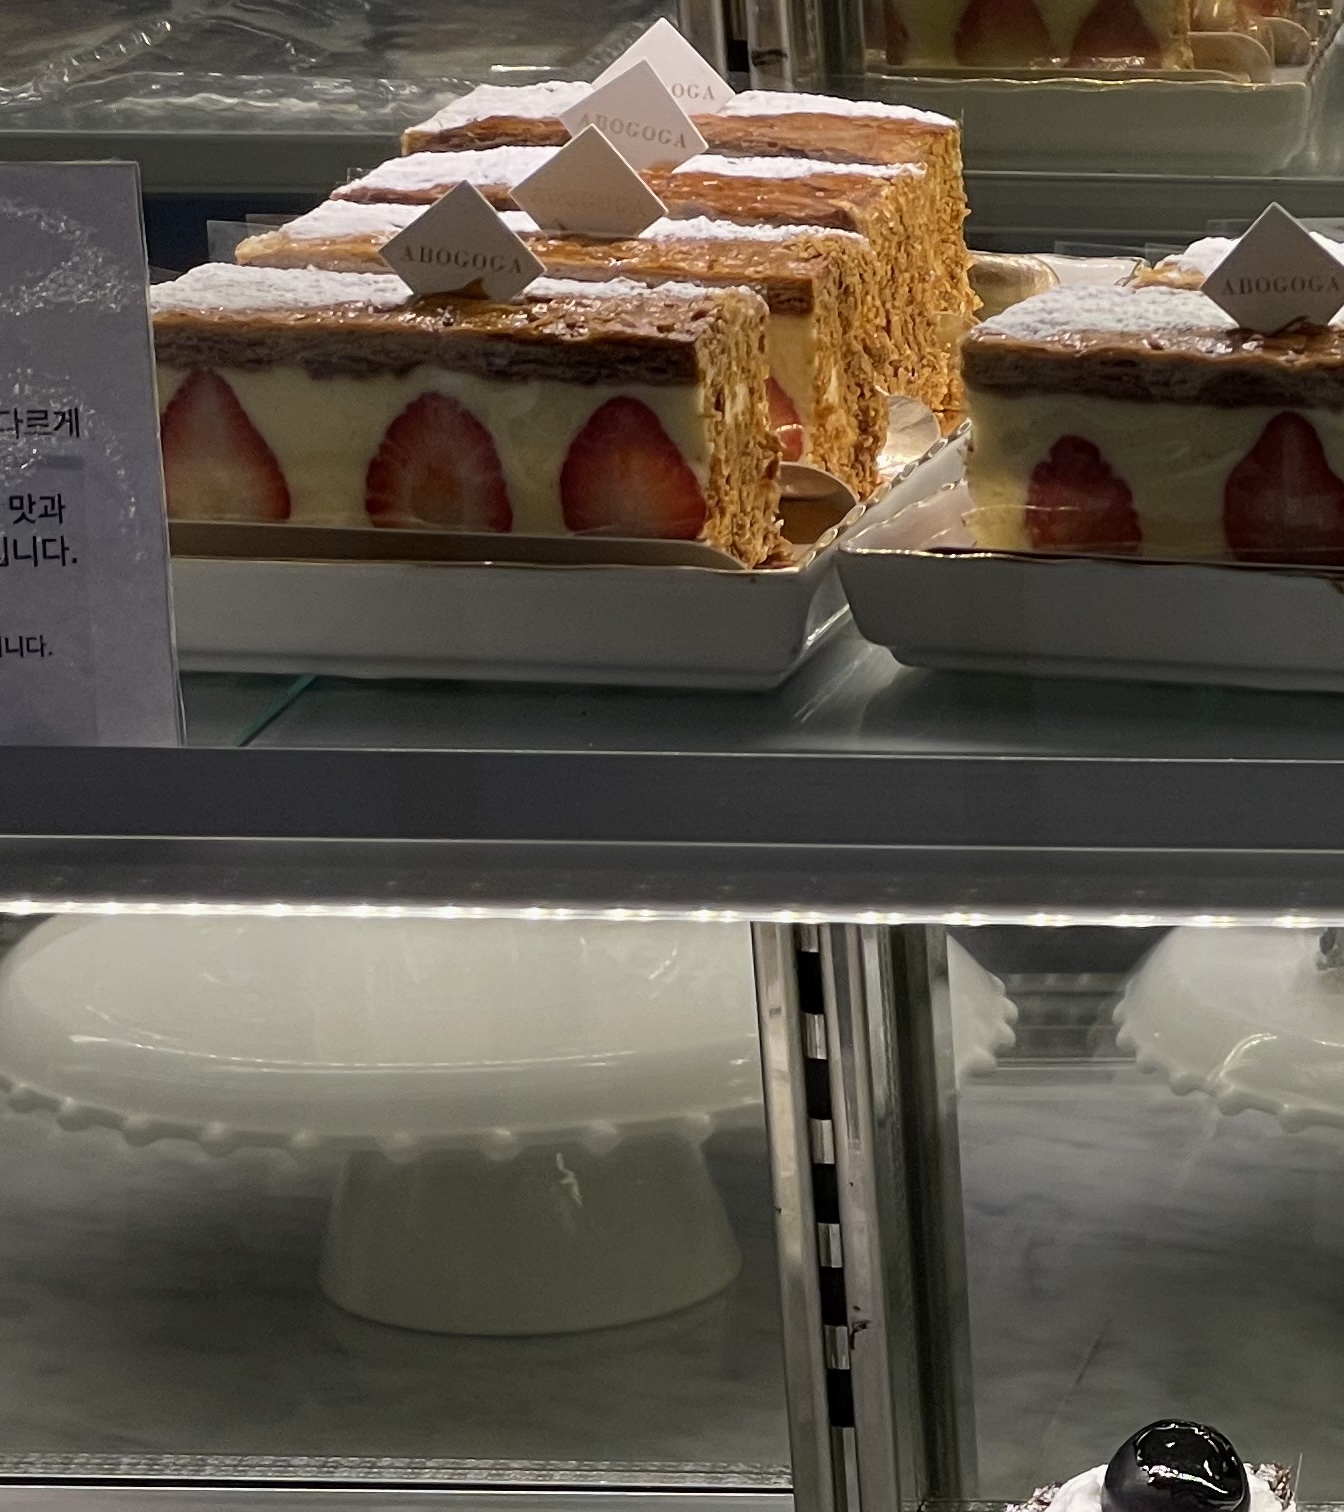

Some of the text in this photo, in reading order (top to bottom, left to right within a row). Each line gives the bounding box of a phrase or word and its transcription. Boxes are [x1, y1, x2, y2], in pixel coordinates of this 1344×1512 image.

[399, 246, 523, 275] ABOGOGA
[1221, 274, 1341, 298] ABOGOGA
[9, 493, 66, 524] 맛과
[0, 634, 53, 658] 니다.
